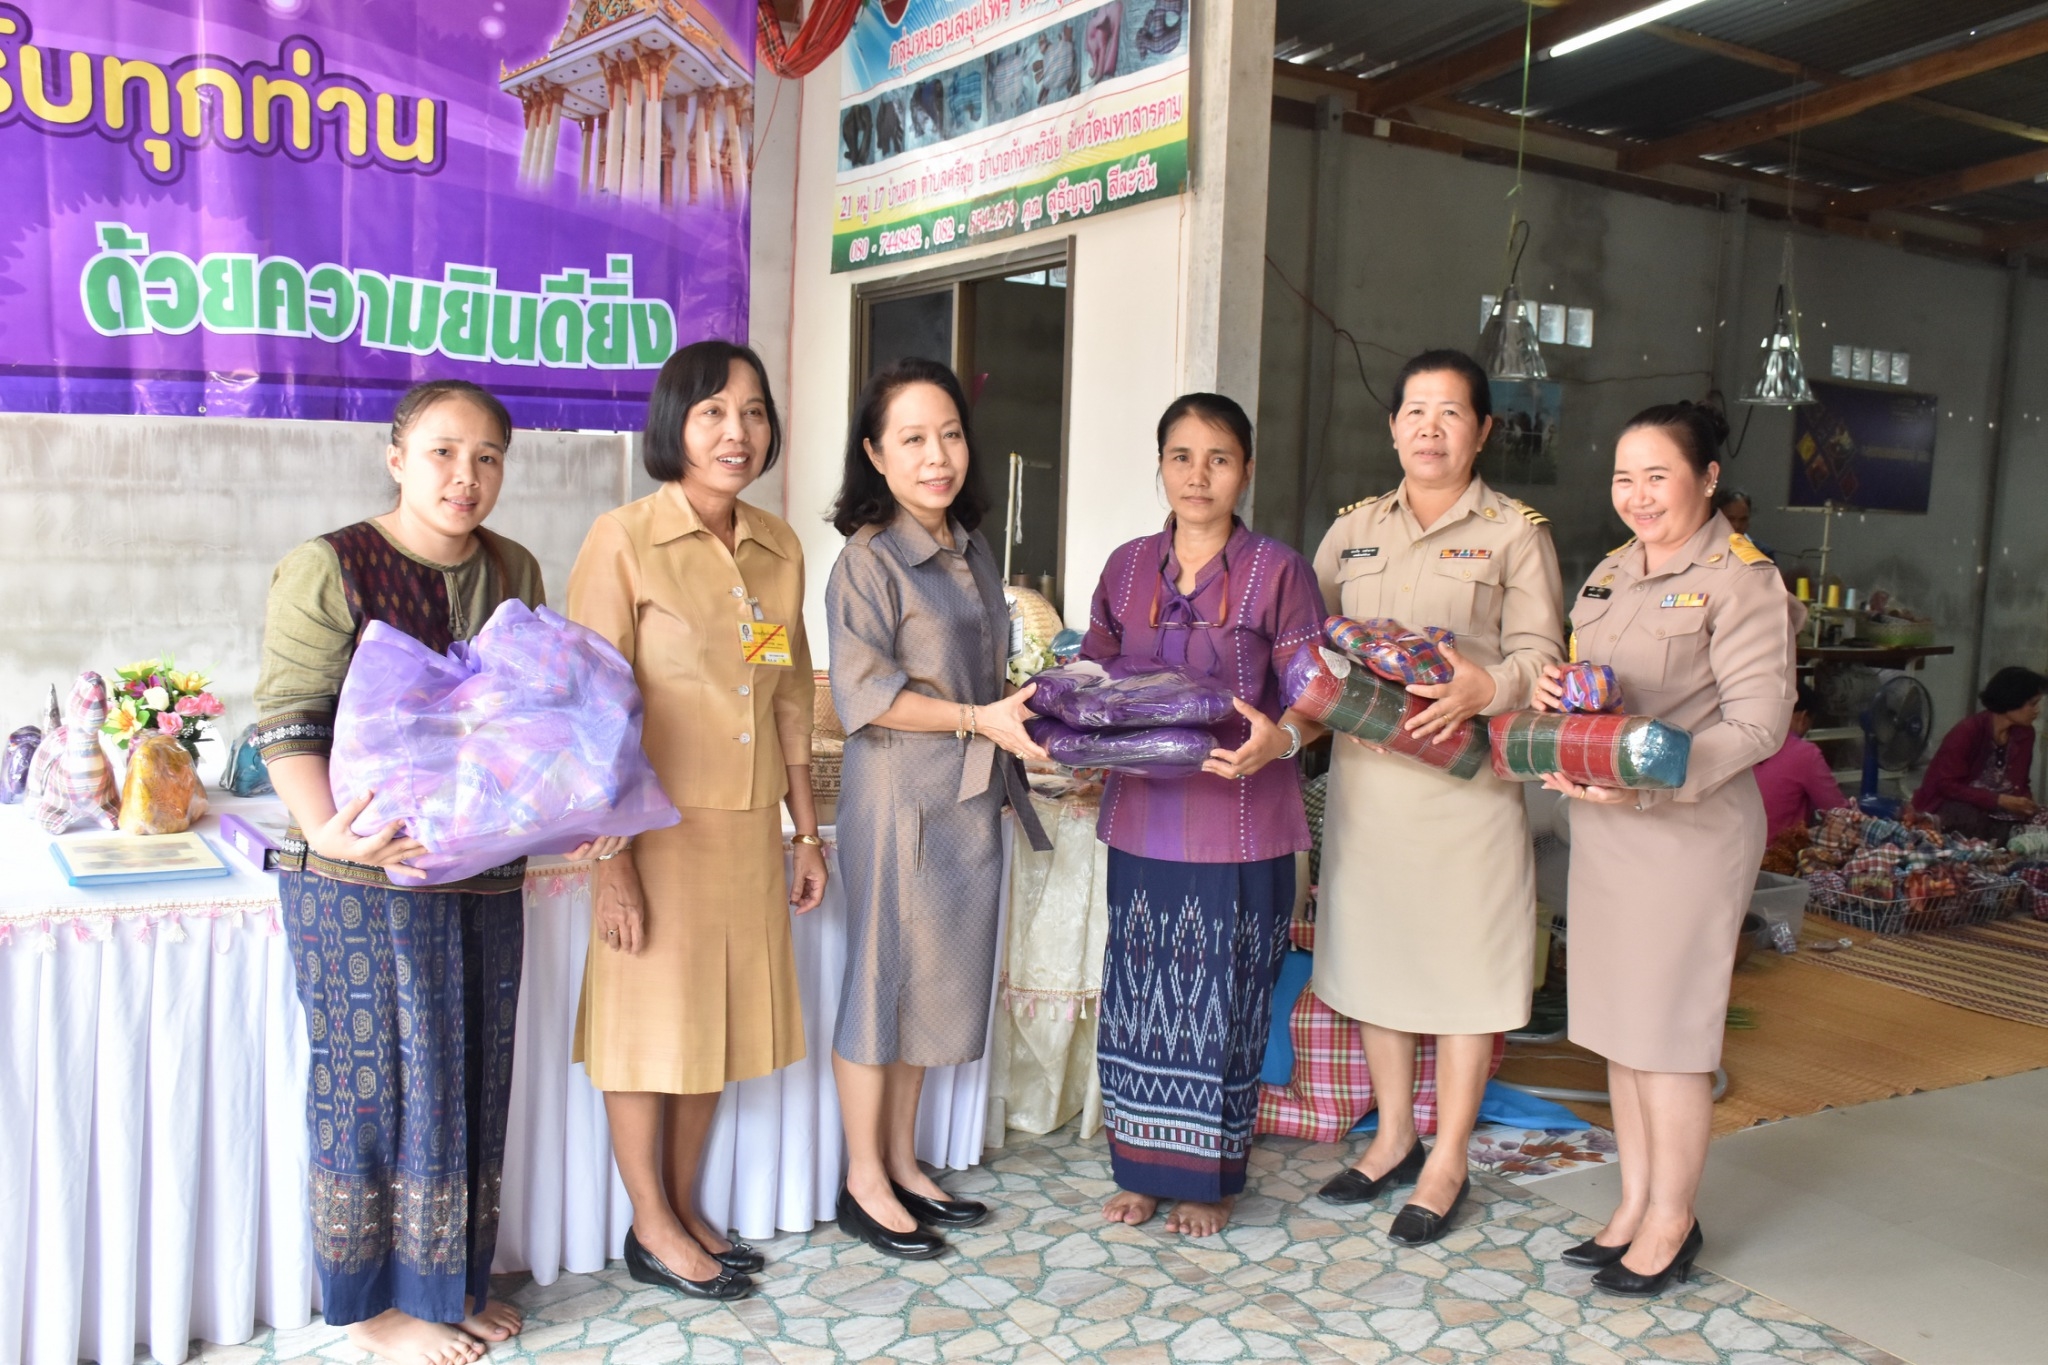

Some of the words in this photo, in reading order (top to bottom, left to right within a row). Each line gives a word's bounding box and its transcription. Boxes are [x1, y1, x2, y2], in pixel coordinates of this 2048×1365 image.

[0, 18, 434, 172] บทุกท่าน
[839, 195, 852, 218] 21
[873, 186, 885, 211] 17
[1022, 195, 1043, 229] คุณ
[81, 222, 677, 369] ด้วยความยินดียิ่ง
